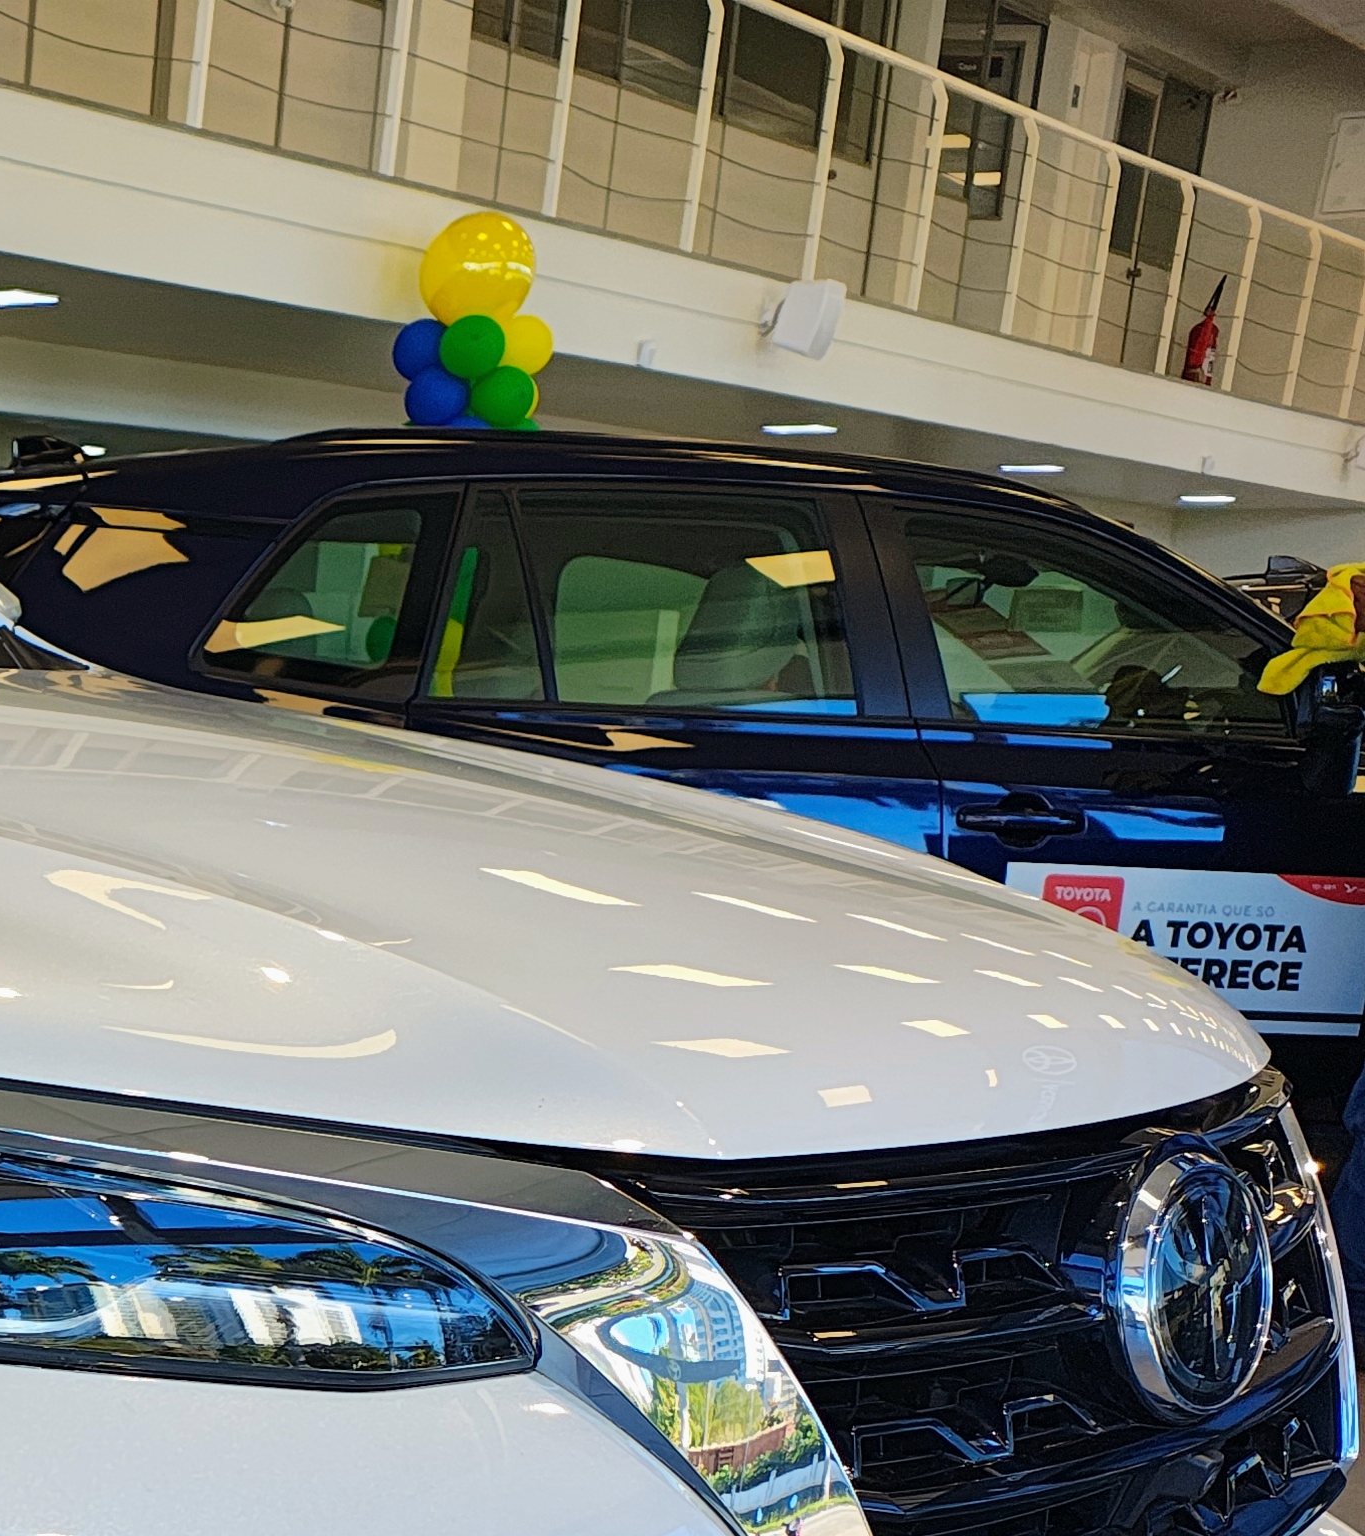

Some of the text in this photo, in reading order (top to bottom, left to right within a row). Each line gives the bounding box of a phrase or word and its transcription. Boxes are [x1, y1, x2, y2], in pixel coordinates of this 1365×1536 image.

[1054, 885, 1112, 902] TOYOTA
[1132, 901, 1142, 912] A
[1222, 904, 1252, 917] QUE
[1131, 919, 1307, 953] A TOYOTA
